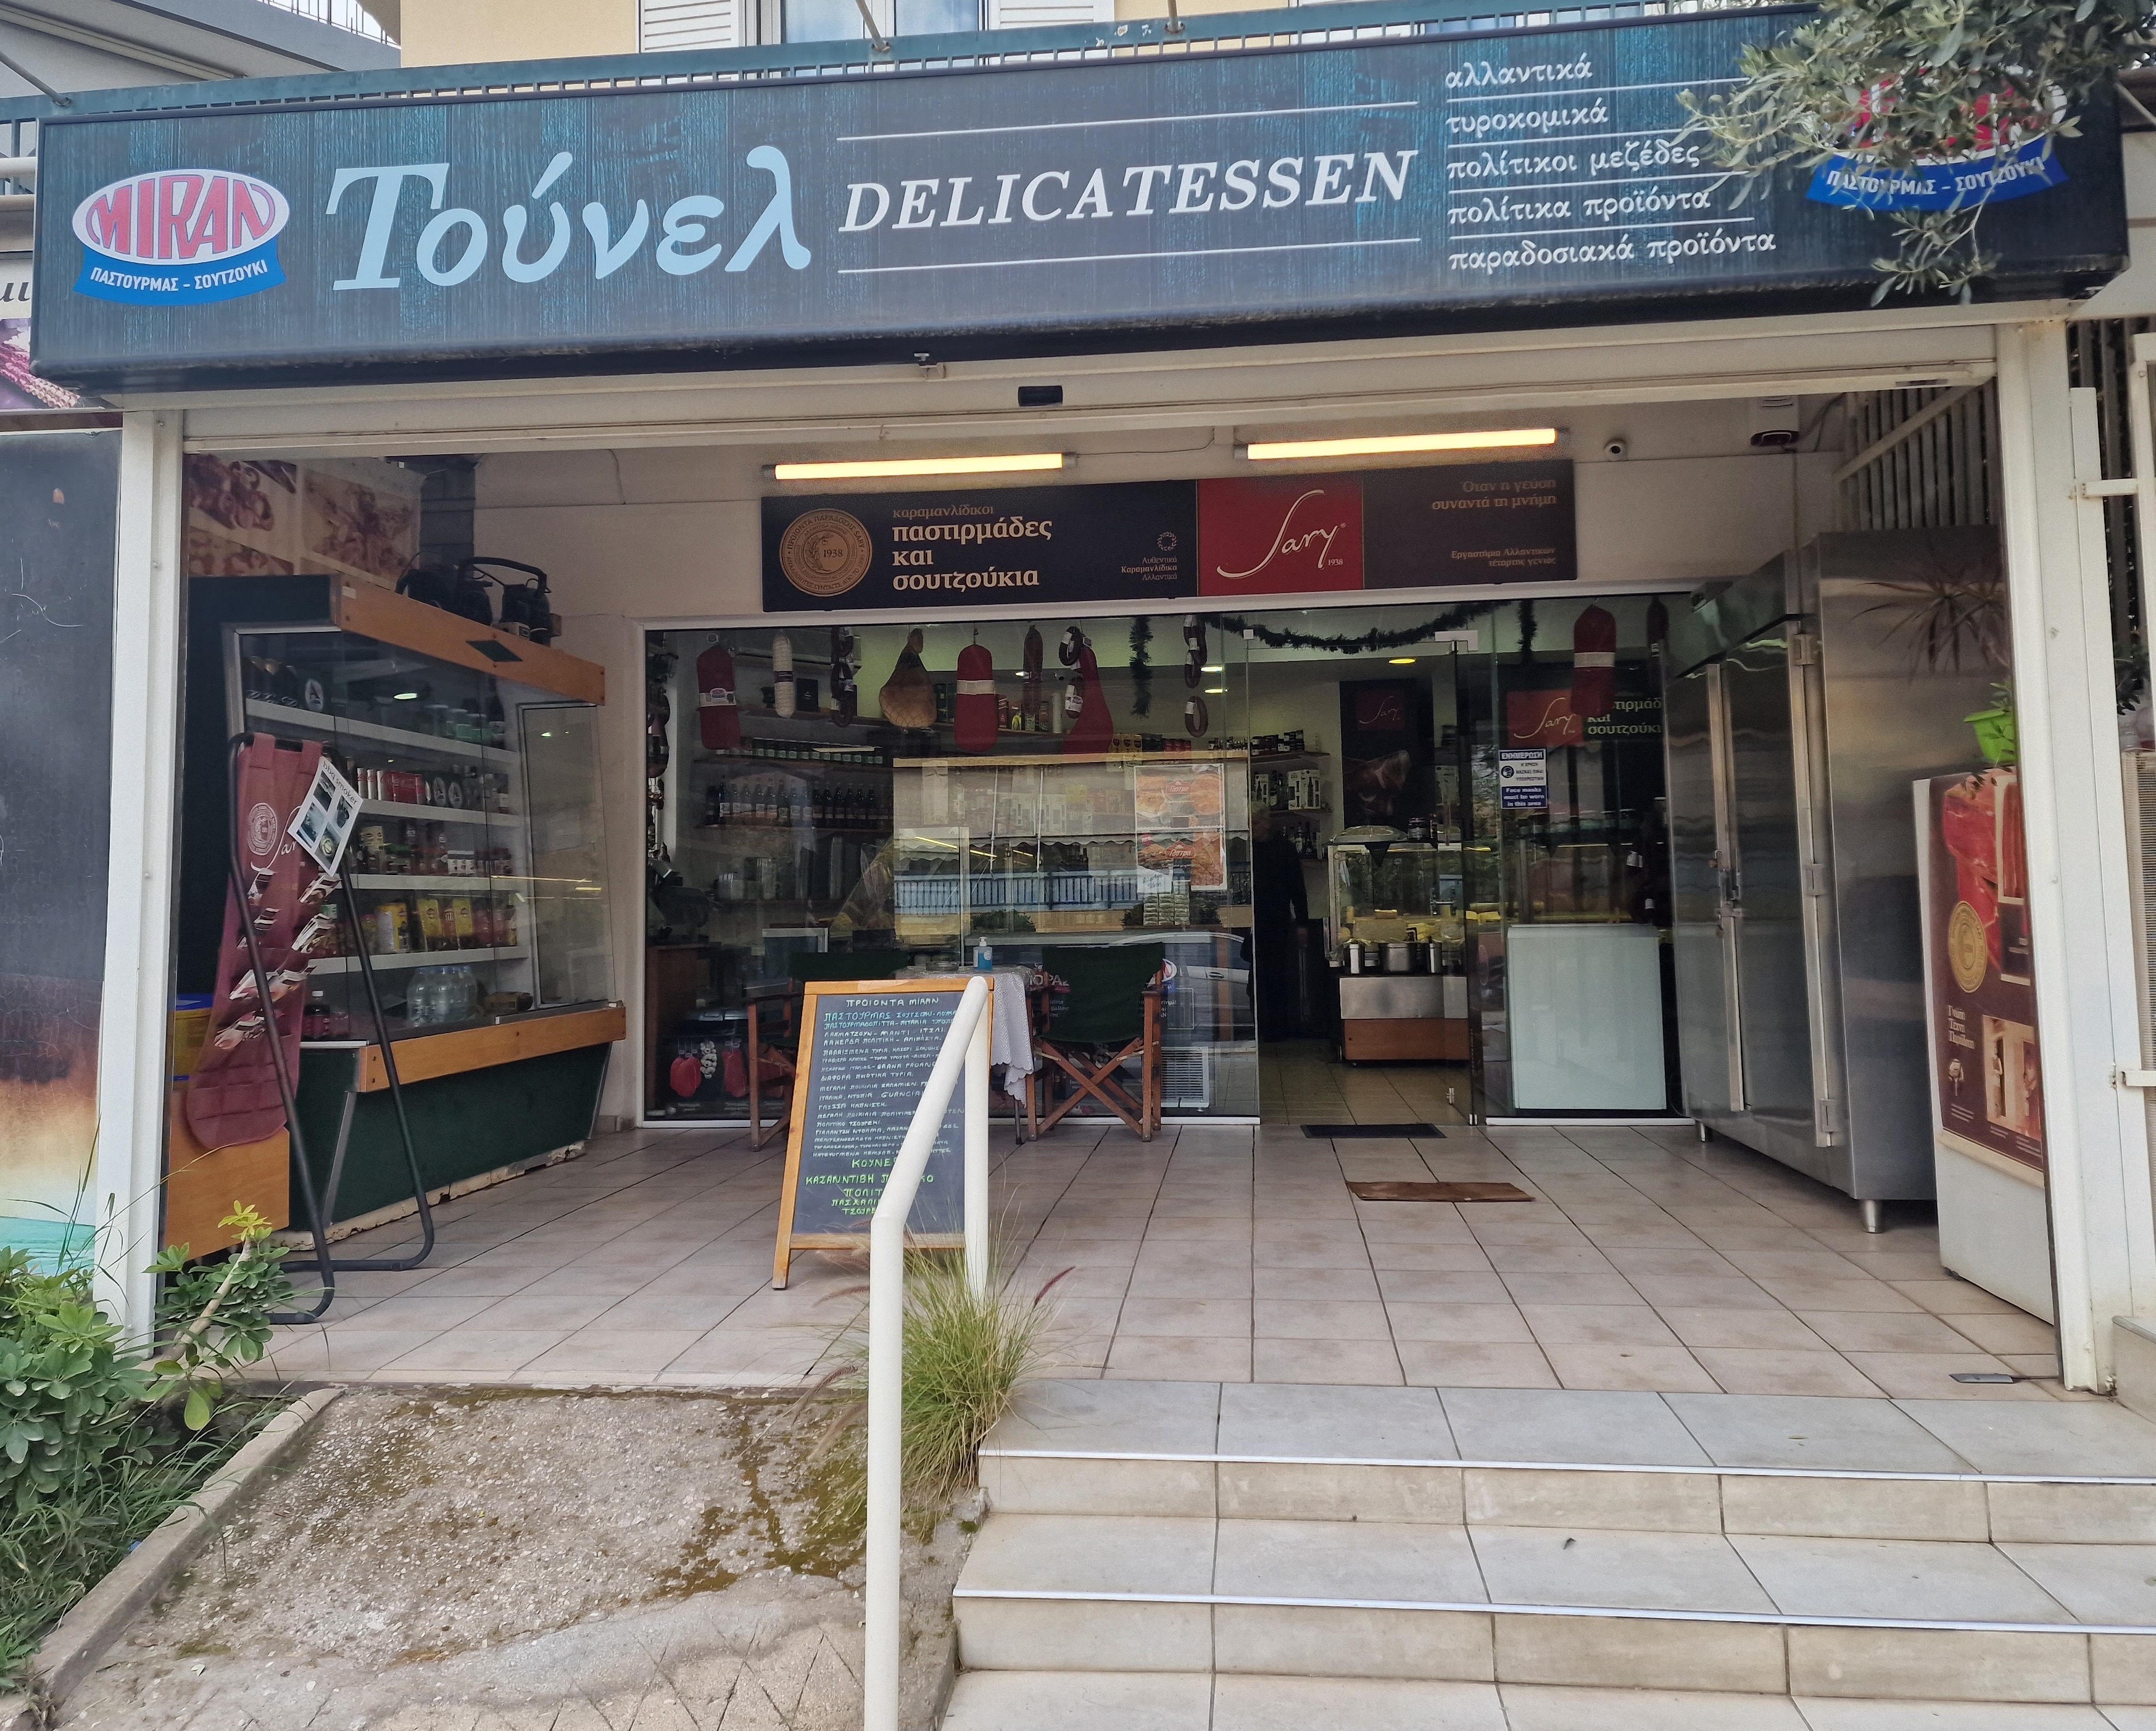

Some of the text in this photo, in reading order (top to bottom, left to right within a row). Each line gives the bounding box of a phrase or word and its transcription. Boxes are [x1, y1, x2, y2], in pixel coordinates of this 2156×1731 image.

[1446, 52, 1593, 88] αλλαντικά
[1446, 98, 1608, 138] τυροκομικά
[1447, 139, 1701, 179] πολίτικοι μεζέδες
[837, 149, 1419, 233] DELICATESSEN
[85, 173, 277, 260] MIRAN
[1448, 186, 1711, 225] πολίτικα προϊόντα
[325, 145, 811, 291] Τούνελ
[1449, 228, 1777, 275] παραδοσιακά προϊόντα
[90, 267, 180, 293] ΠΑΣΤΟΥΡΜΑΣ
[194, 260, 268, 290] ΣΟΥΤΖΟΥΚΙ
[892, 504, 995, 521] καραμανλίδικοι
[892, 514, 1053, 546] παστιρμάδες
[823, 549, 844, 558] 1938
[892, 549, 933, 567] και
[892, 567, 1039, 593] σουτζούκια
[1614, 697, 1662, 712] τιρμάδ
[1587, 722, 1662, 736] σουτζούκι
[845, 998, 905, 1008] ΠΡΟΙΟΝΤΑ
[823, 1011, 891, 1022] ΠΑΣΤΟΥΡΜΑΣ
[823, 1038, 860, 1047] ΛΑΚΕΡΔΑ
[831, 1198, 879, 1206] ΠΑΣΧΑΛΙ
[843, 1188, 883, 1197] ΠΟΛΙΤ
[841, 1207, 876, 1215] ΤΣΟΥΡΕ
